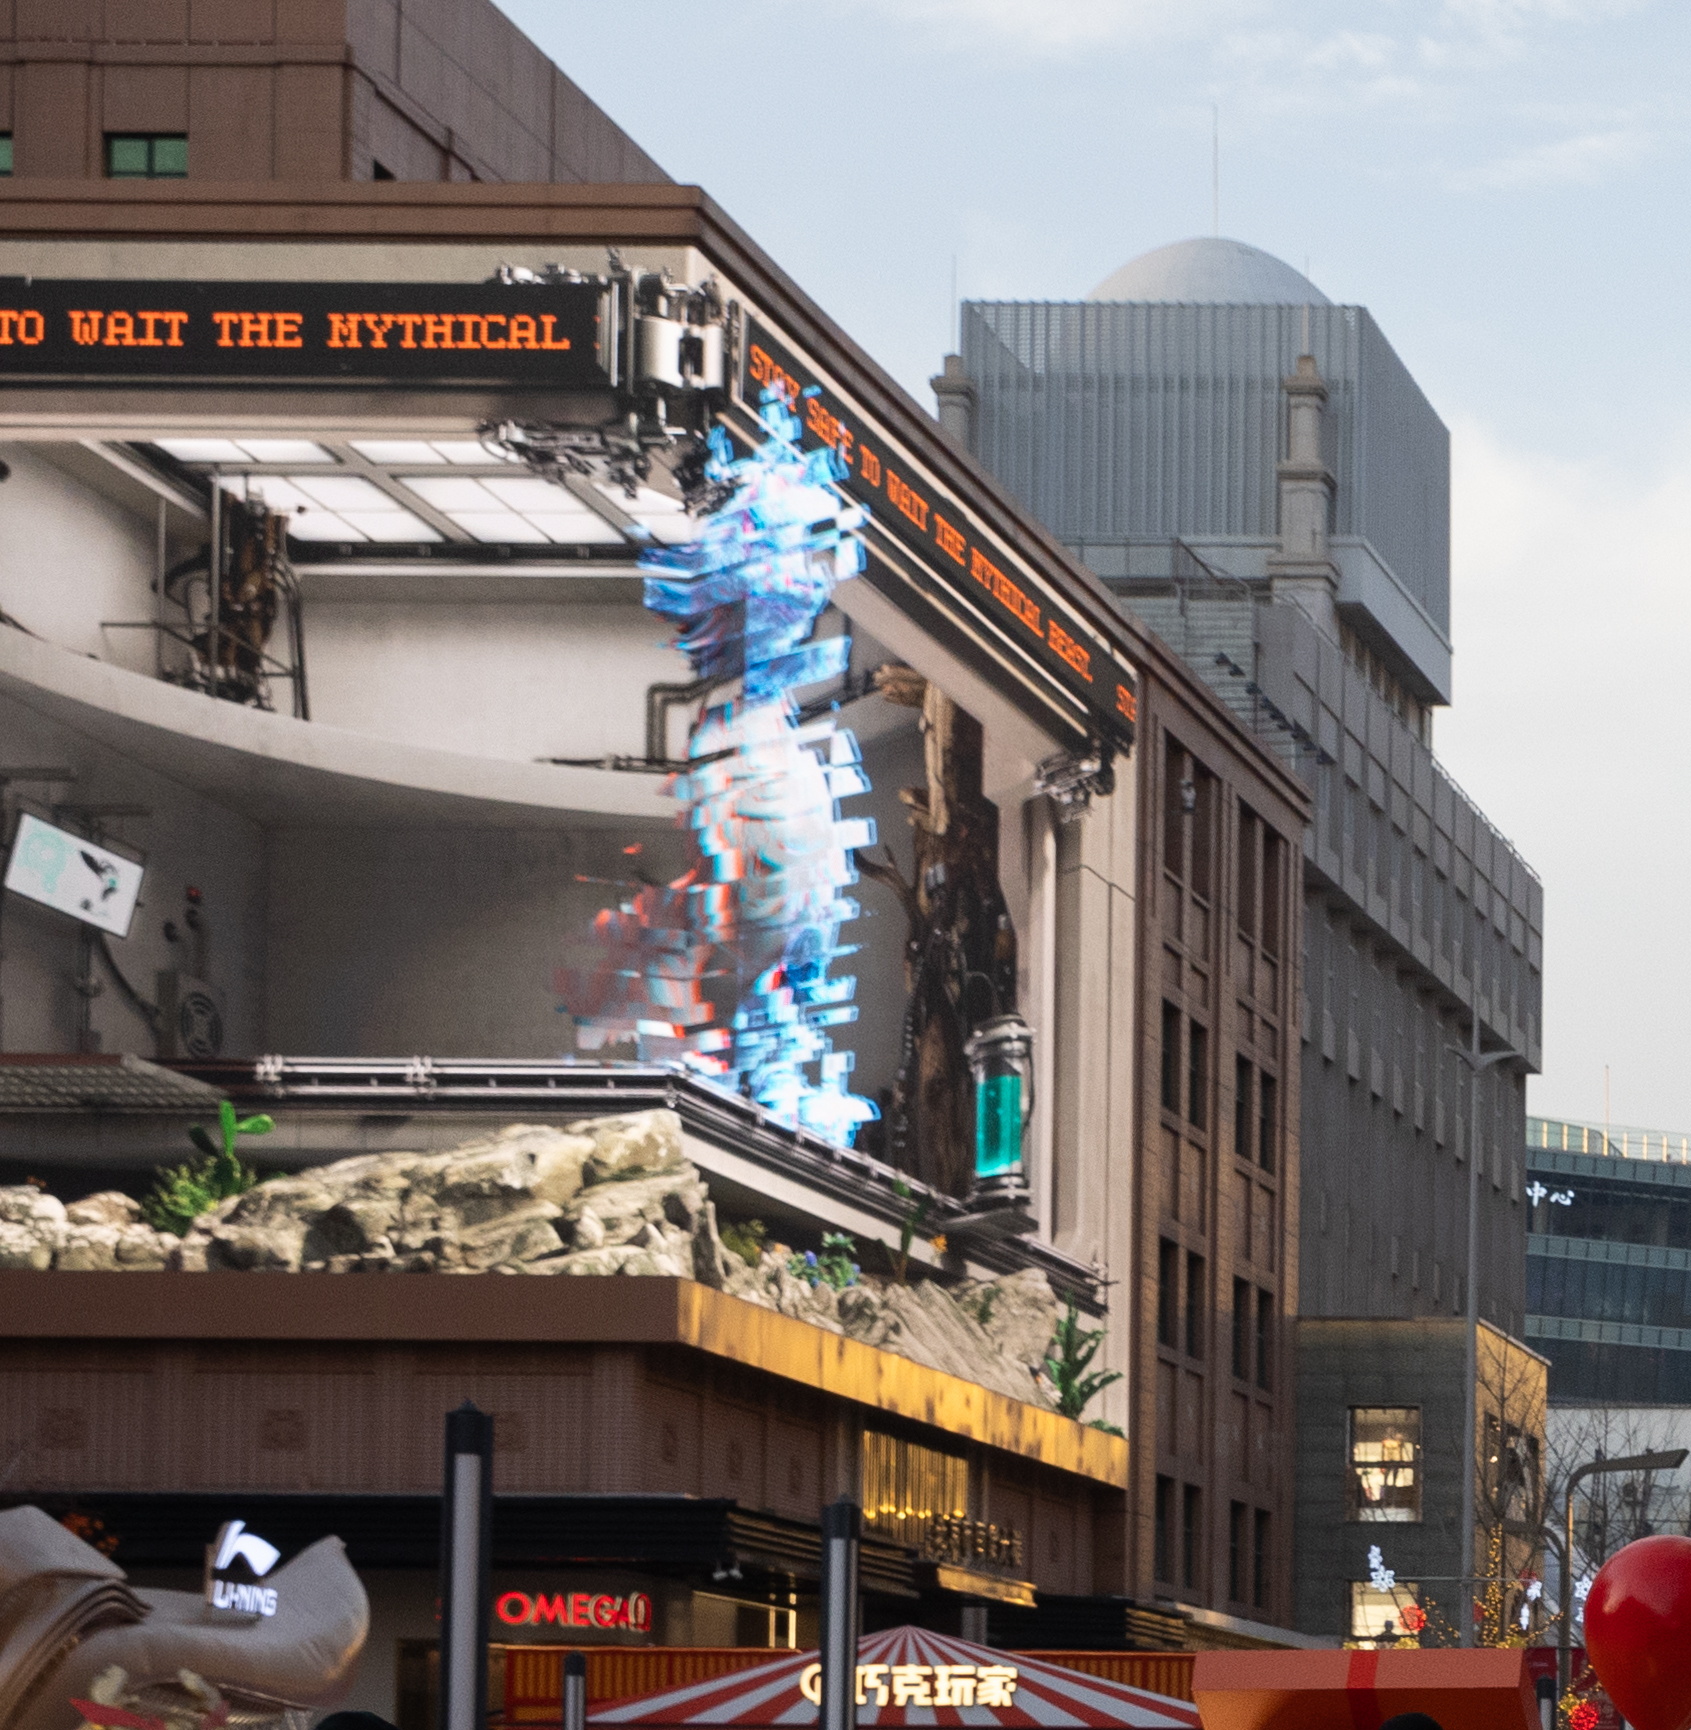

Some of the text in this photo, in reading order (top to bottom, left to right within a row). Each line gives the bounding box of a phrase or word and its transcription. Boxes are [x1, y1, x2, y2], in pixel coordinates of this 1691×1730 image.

[69, 310, 189, 347] WAIT
[213, 312, 304, 348] THE
[326, 312, 571, 350] MYTHICAL
[933, 512, 967, 567] THE
